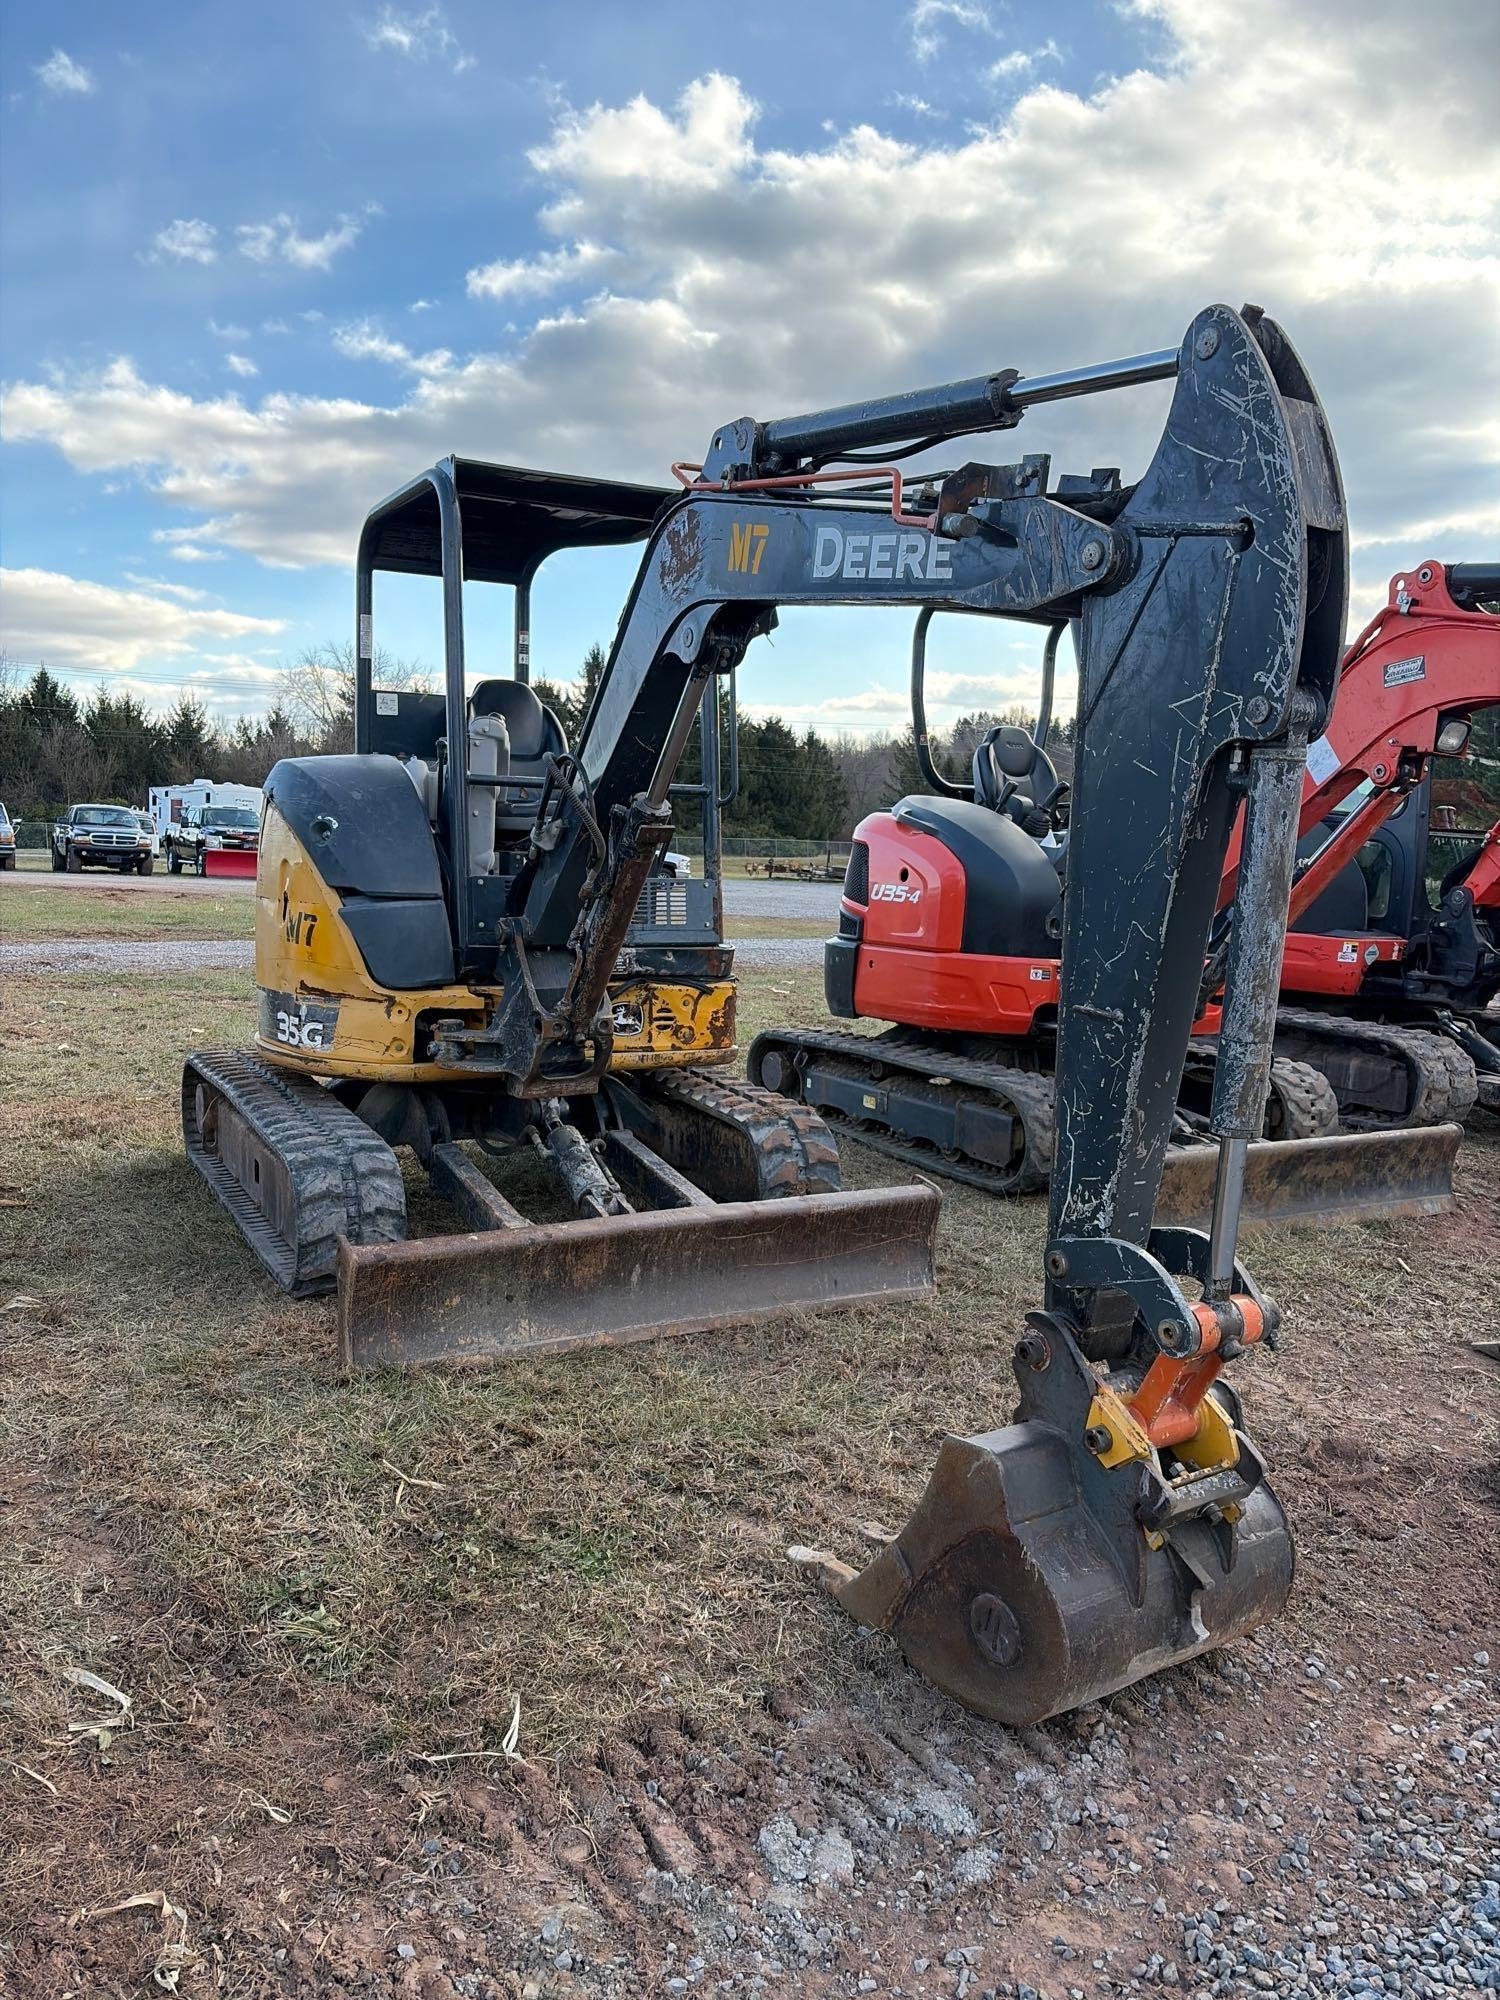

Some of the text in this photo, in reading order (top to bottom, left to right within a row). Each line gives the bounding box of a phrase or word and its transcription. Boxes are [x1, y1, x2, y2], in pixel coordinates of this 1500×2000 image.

[728, 523, 770, 575] M7
[812, 527, 956, 579] DEERE
[870, 883, 921, 904] U35-4
[276, 1010, 324, 1049] 35G
